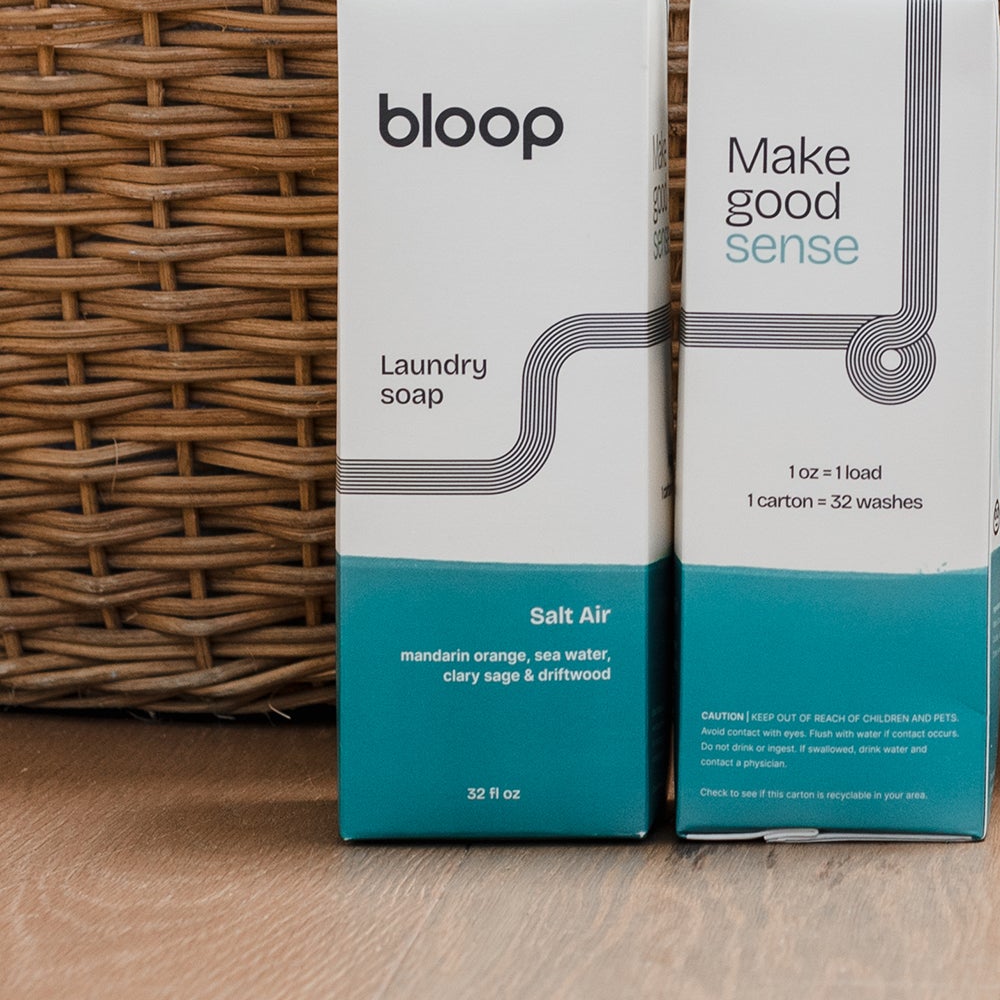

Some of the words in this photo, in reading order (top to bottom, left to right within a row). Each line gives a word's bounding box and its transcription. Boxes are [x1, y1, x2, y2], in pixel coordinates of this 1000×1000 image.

[378, 92, 565, 161] bloop
[728, 135, 851, 176] Make
[725, 181, 841, 227] good
[725, 233, 860, 266] sense
[381, 353, 487, 380] Laundry
[380, 387, 444, 410] soap
[789, 464, 795, 479] 1
[798, 467, 820, 480] oz
[822, 469, 832, 477] =
[835, 465, 841, 480] 1
[845, 464, 882, 481] load
[747, 493, 753, 508] 1
[757, 494, 814, 509] carton
[817, 498, 827, 506] =
[830, 494, 853, 509] 32
[855, 494, 924, 510] washes
[530, 606, 574, 626] Salt
[578, 604, 612, 625] Air
[400, 648, 471, 663] mandarin
[473, 651, 531, 666] orange,
[534, 650, 562, 662] sea
[564, 647, 612, 662] water,
[442, 669, 481, 686] clary
[483, 671, 521, 686] sage
[523, 668, 535, 682] &
[537, 666, 612, 682] driftwood
[701, 711, 744, 721] CAUTION
[751, 713, 775, 722] KEEP
[777, 713, 796, 722] OUT
[799, 714, 812, 722] OF
[814, 714, 845, 723] REACH
[848, 714, 860, 723] OF
[863, 714, 909, 723] CHILDREN
[911, 714, 931, 723] AND
[933, 713, 959, 722] PETS.
[701, 727, 725, 736] Avoid
[727, 728, 760, 737] contact
[763, 729, 781, 737] with
[784, 730, 806, 739] eyes.
[809, 729, 833, 738] Flush
[836, 730, 854, 738] with
[856, 730, 881, 738] water
[884, 729, 890, 738] if
[892, 730, 925, 738] contact
[927, 730, 959, 738] occurs.
[701, 742, 713, 751] Do
[715, 743, 730, 751] not
[731, 743, 754, 752] drink
[767, 744, 796, 754] ingest.
[808, 745, 856, 754] swallowed,
[859, 745, 881, 753] drink
[910, 745, 927, 753] and
[701, 758, 734, 766] contact
[743, 759, 787, 768] physician.
[466, 787, 486, 801] 32
[488, 786, 500, 800] fl
[502, 789, 521, 800] oz
[700, 788, 728, 797] Check
[730, 789, 739, 797] to
[759, 789, 765, 798] if
[767, 790, 784, 798] this
[786, 791, 815, 799] carton
[816, 791, 824, 799] is
[826, 791, 872, 801] recyclable
[874, 791, 882, 799] in
[884, 792, 904, 801] your
